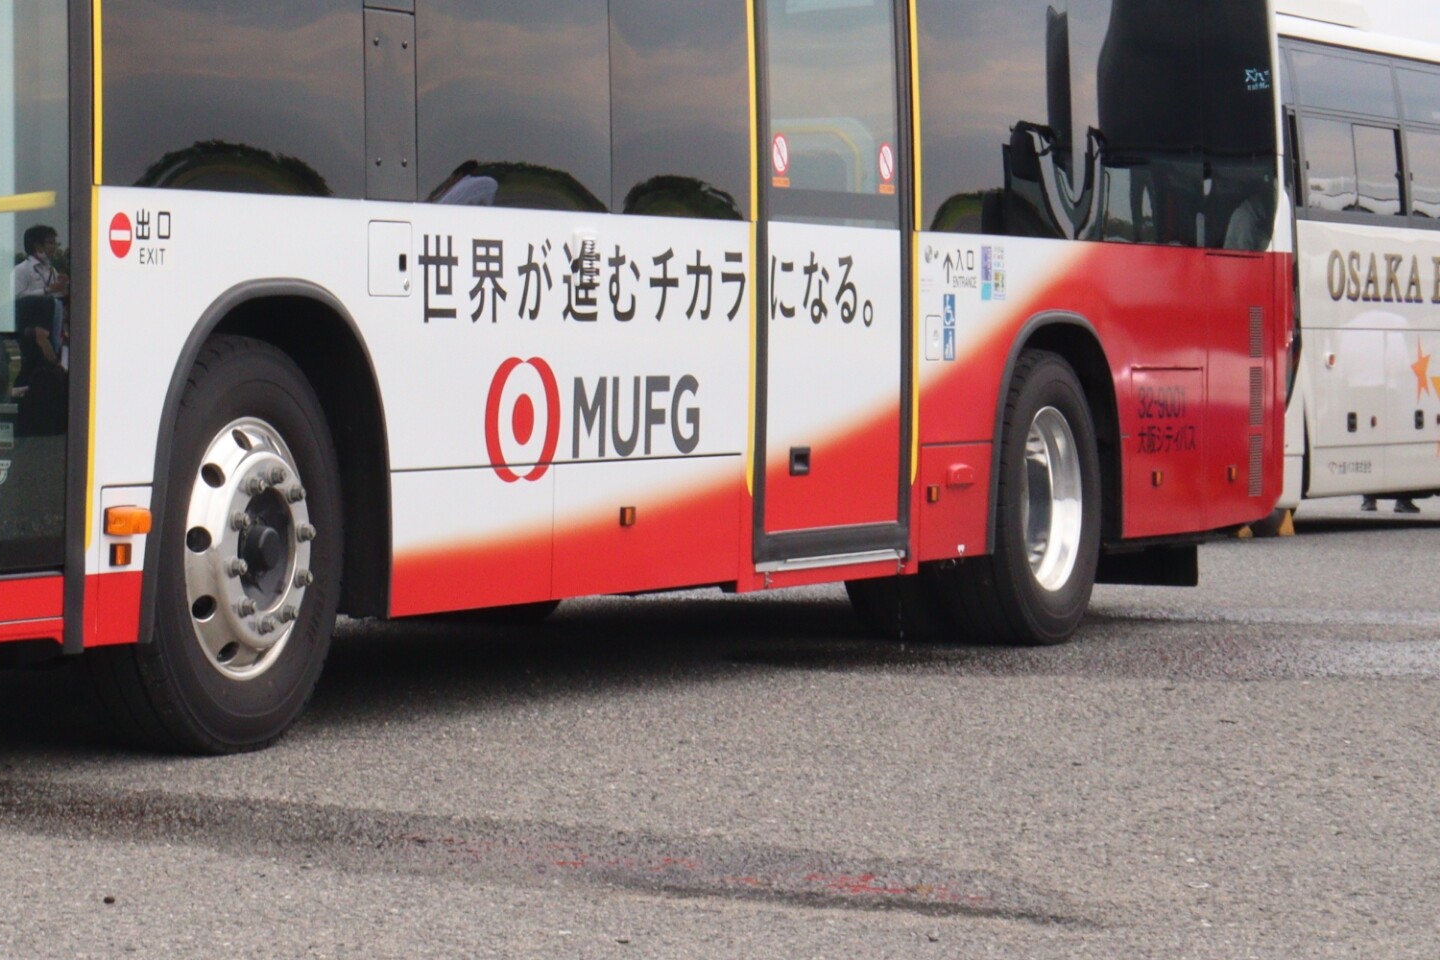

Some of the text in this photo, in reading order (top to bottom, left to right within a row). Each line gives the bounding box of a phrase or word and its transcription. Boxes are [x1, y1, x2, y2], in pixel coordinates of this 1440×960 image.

[136, 208, 171, 240] 出口
[139, 248, 166, 265] EXIT
[955, 249, 974, 271] 入口
[952, 275, 977, 289] ENTRANCE
[1327, 249, 1424, 303] OSAKA
[571, 373, 700, 459] MUFG
